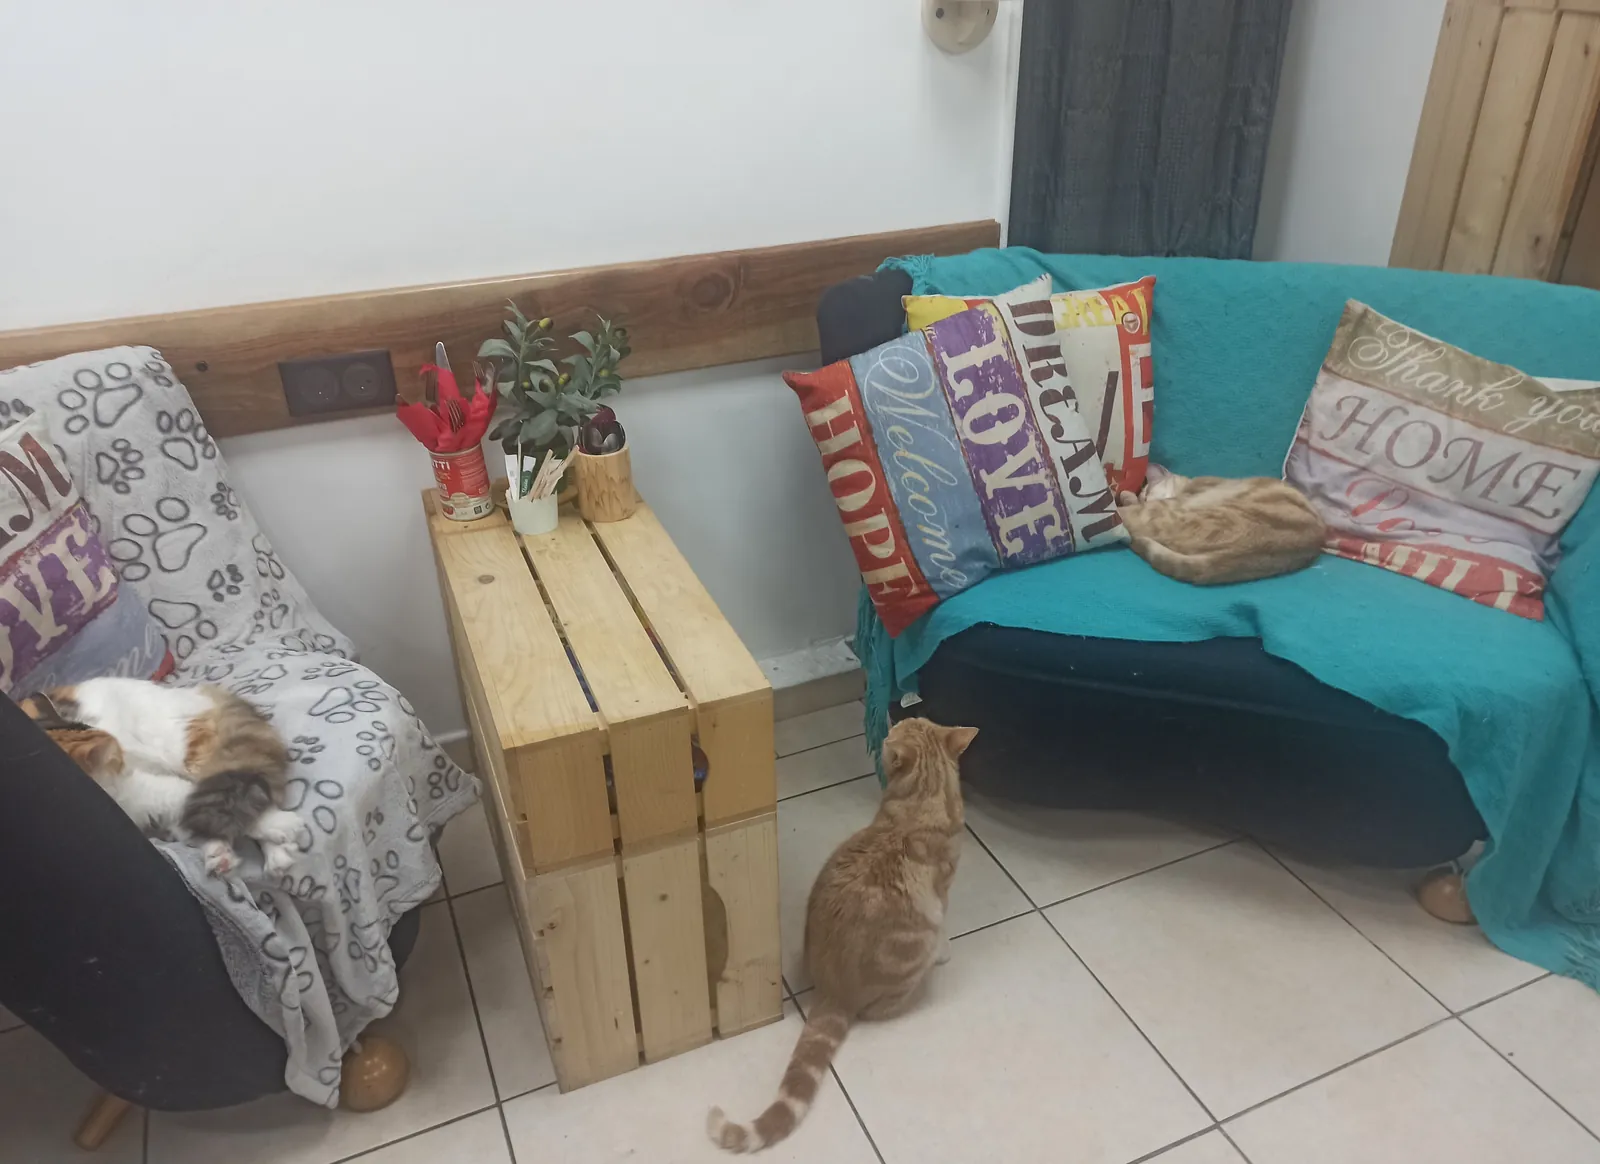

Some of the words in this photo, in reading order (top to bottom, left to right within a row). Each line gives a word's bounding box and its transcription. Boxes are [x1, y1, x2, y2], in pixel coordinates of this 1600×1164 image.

[864, 345, 968, 589] Welcome
[942, 336, 1070, 556] LOVE
[1008, 301, 1123, 543] DREAM
[1318, 395, 1581, 519] HOME
[1347, 322, 1525, 412] Thank
[807, 390, 920, 605] HOPE
